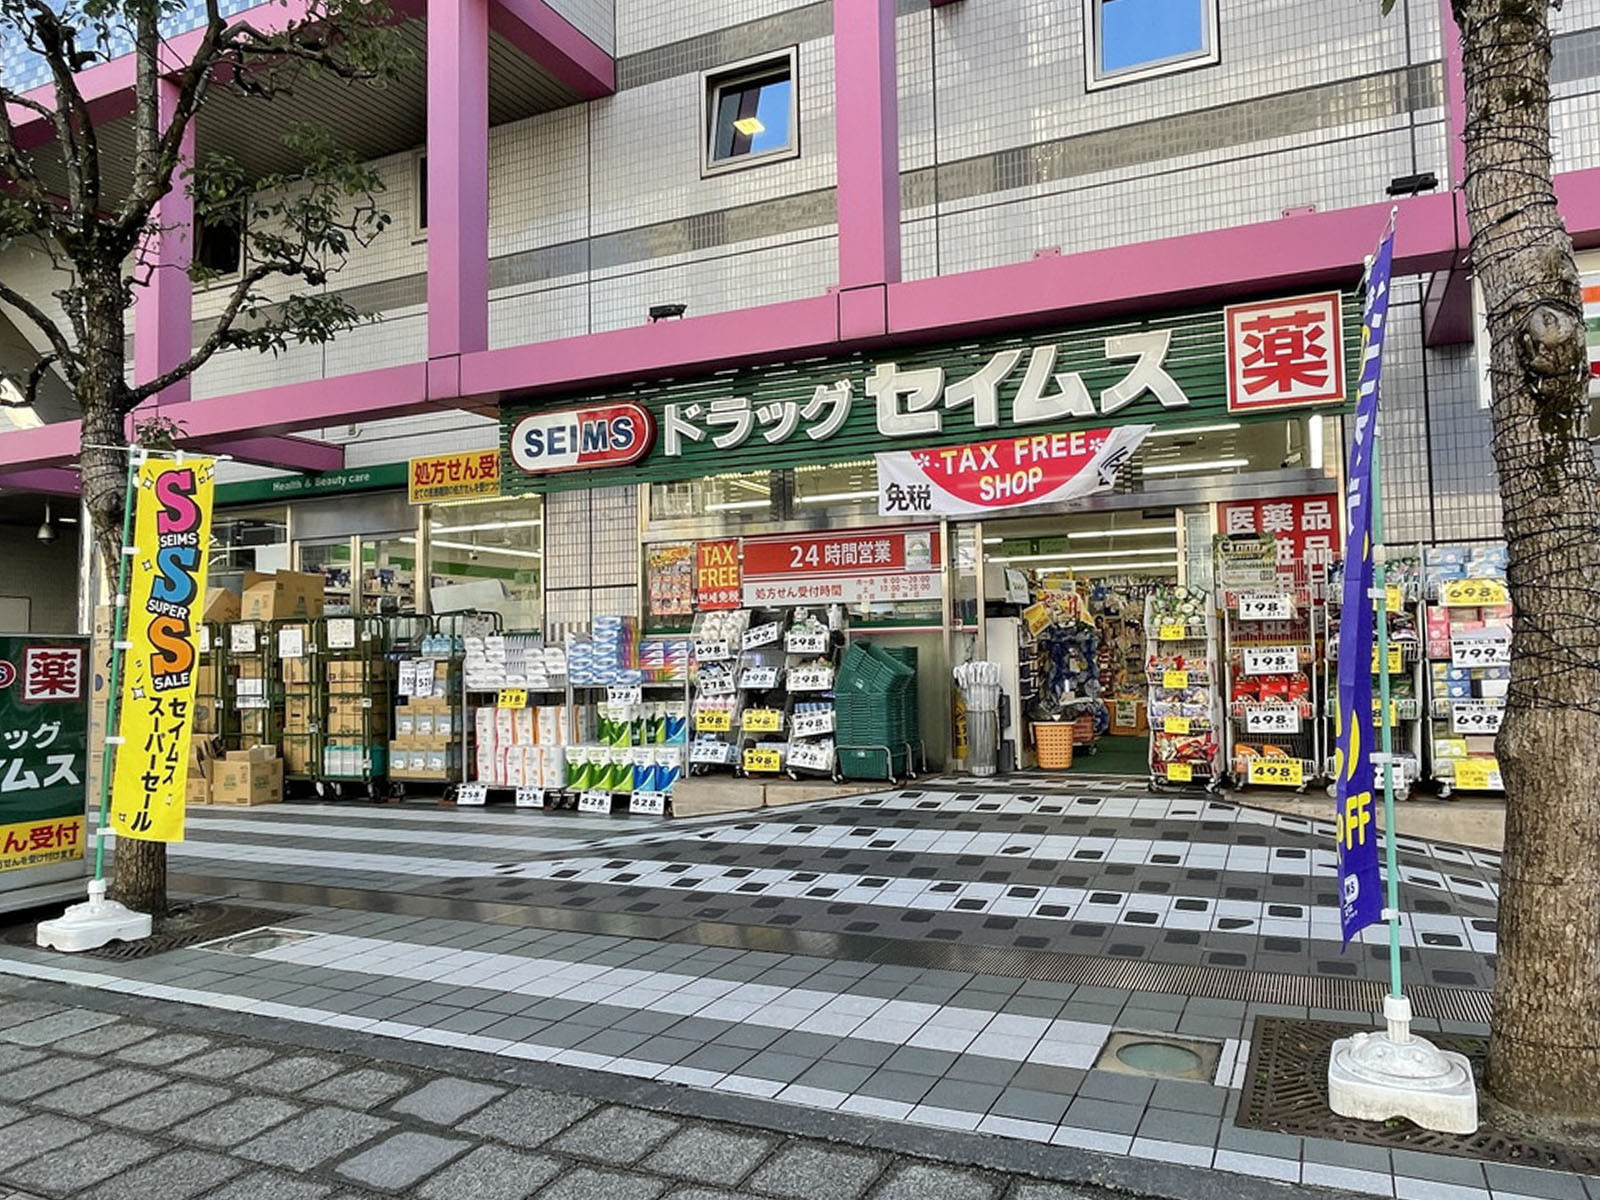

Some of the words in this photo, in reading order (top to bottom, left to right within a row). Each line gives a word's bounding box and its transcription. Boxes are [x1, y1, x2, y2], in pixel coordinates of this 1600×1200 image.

[1241, 309, 1330, 394] 薬
[866, 330, 1190, 437] セイムス
[664, 379, 854, 457] ドラッグ
[524, 418, 634, 459] SEIMS
[940, 444, 999, 475] TAX
[1014, 431, 1087, 466] FREE
[348, 473, 370, 483] care
[415, 454, 500, 486] 処方せん受
[979, 467, 1044, 502] SHOP
[157, 469, 201, 534] S
[885, 482, 932, 511] 免税
[1226, 500, 1333, 534] 医薬品
[160, 532, 197, 547] SEIMS
[790, 540, 892, 568] 24時間営業
[702, 545, 735, 566] TAX
[153, 547, 199, 604] S
[699, 567, 740, 588] FREE
[1245, 602, 1279, 612] 198
[1450, 588, 1491, 598] 698
[147, 600, 188, 619] SUPER
[149, 616, 194, 675] S
[1455, 648, 1497, 659] 799
[29, 651, 77, 695] 薬
[1252, 656, 1286, 666] 198
[154, 673, 190, 690] SALE
[1250, 715, 1287, 724] 498
[1456, 714, 1499, 725] 698
[163, 697, 187, 785] セイムス
[0, 754, 80, 792] ムス
[131, 696, 165, 832] スーパーセール
[1254, 766, 1291, 777] 498
